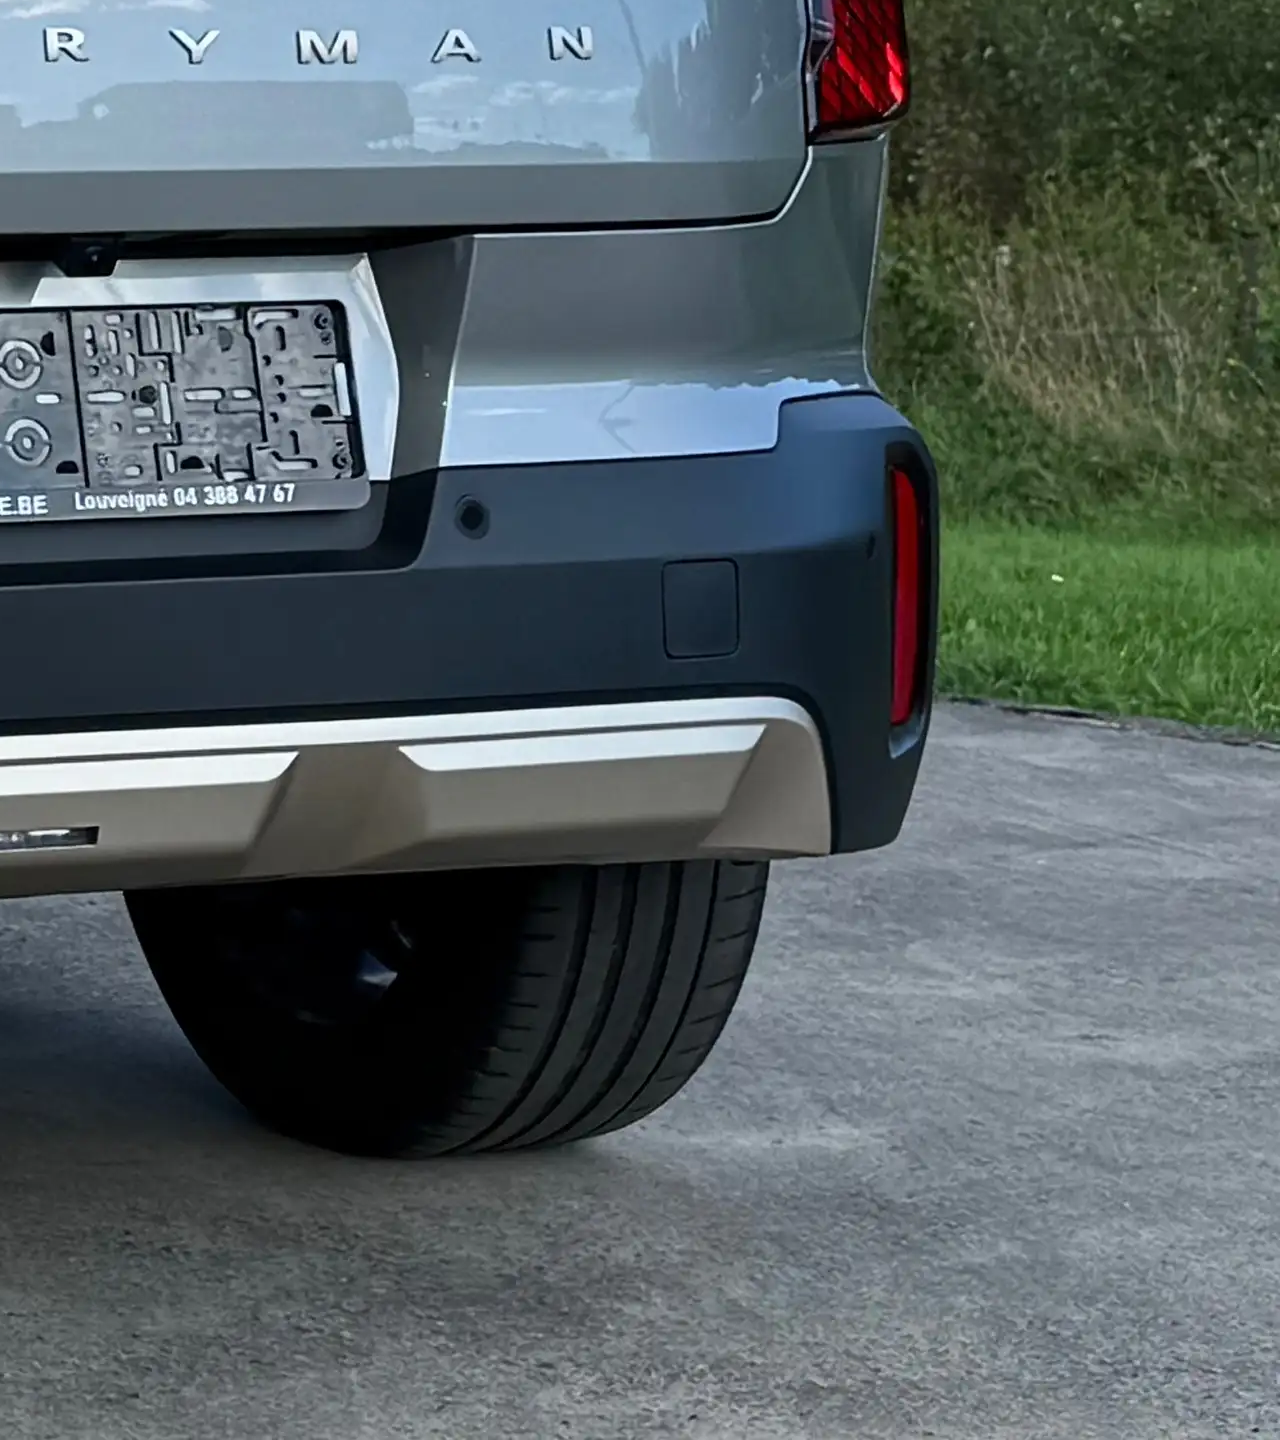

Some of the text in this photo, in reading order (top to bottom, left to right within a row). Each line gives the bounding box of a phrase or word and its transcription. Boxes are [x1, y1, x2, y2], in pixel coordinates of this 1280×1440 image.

[174, 487, 198, 507] 04
[203, 485, 239, 506] 388
[244, 484, 266, 504] 47
[273, 482, 296, 503] 67
